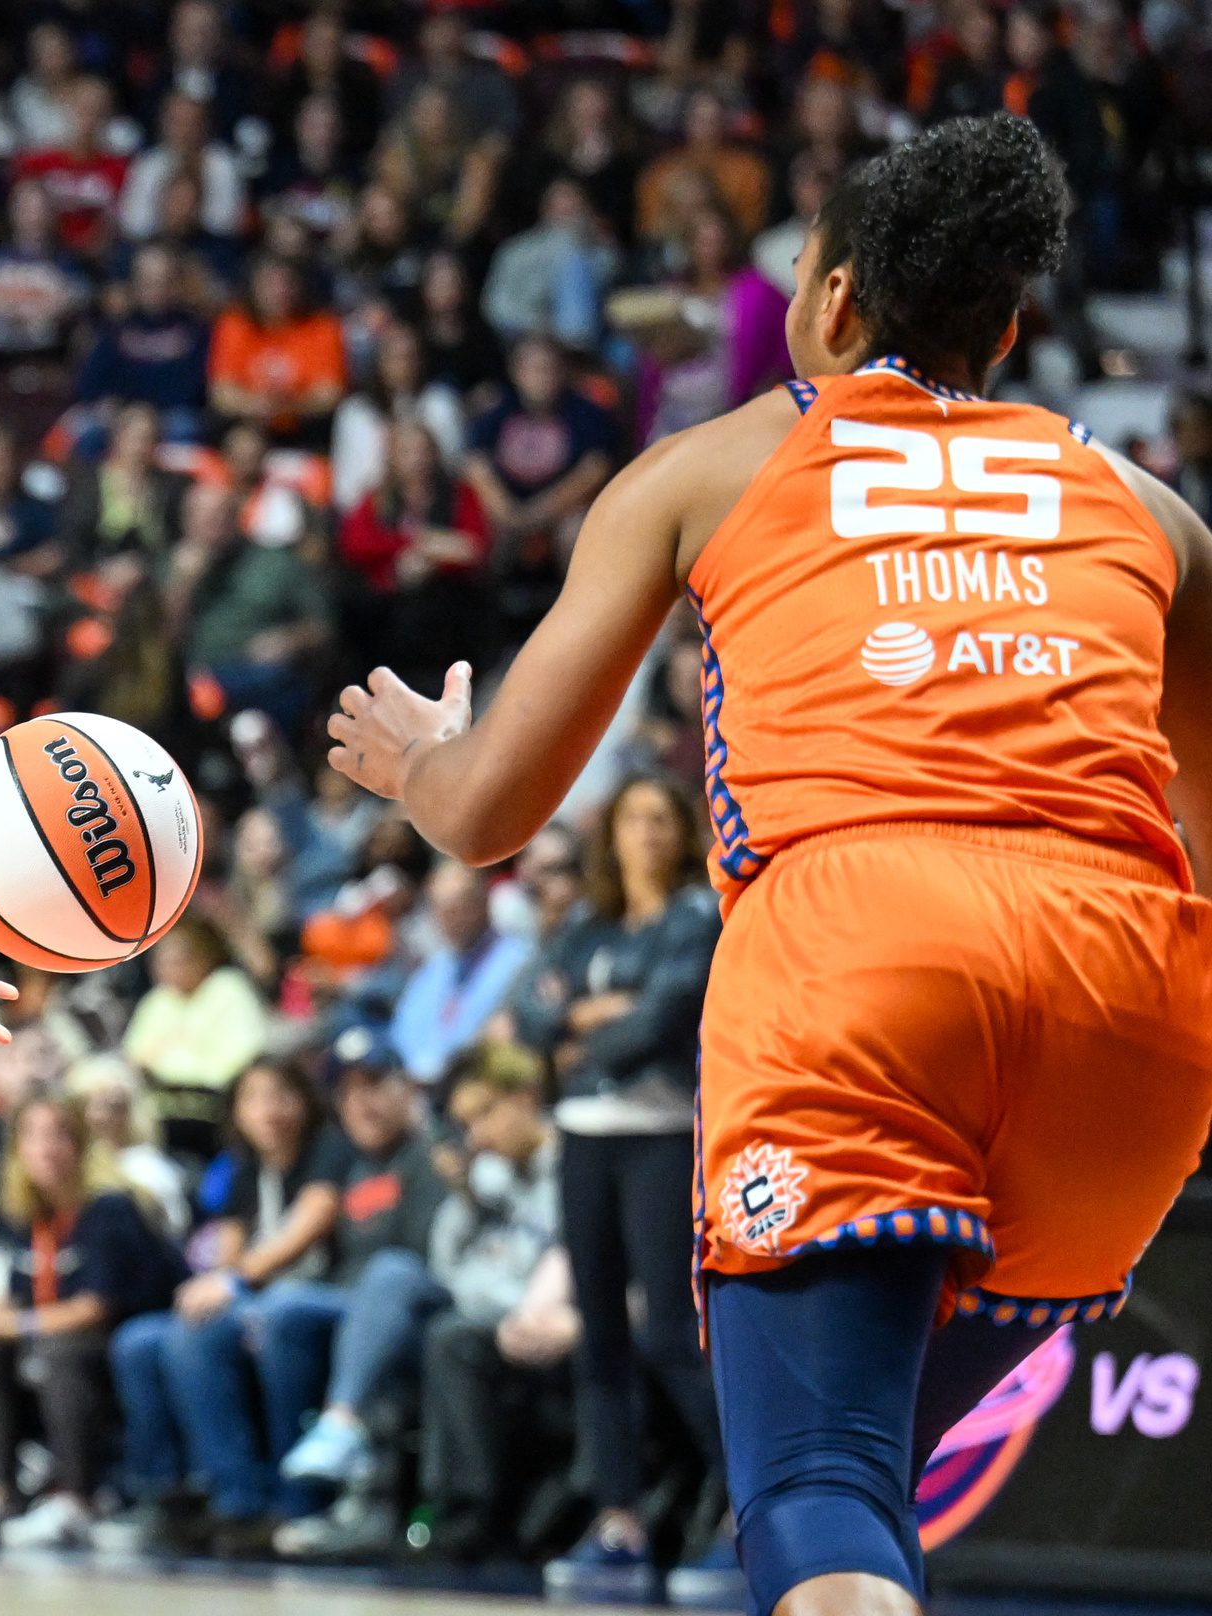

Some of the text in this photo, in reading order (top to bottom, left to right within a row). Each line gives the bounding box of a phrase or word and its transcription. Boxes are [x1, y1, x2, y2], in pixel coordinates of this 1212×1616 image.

[830, 418, 1062, 540] 25
[865, 550, 1048, 606] THOMAS
[946, 631, 1081, 677] AT&T
[43, 735, 136, 899] Wilson
[1090, 1350, 1201, 1439] VS
